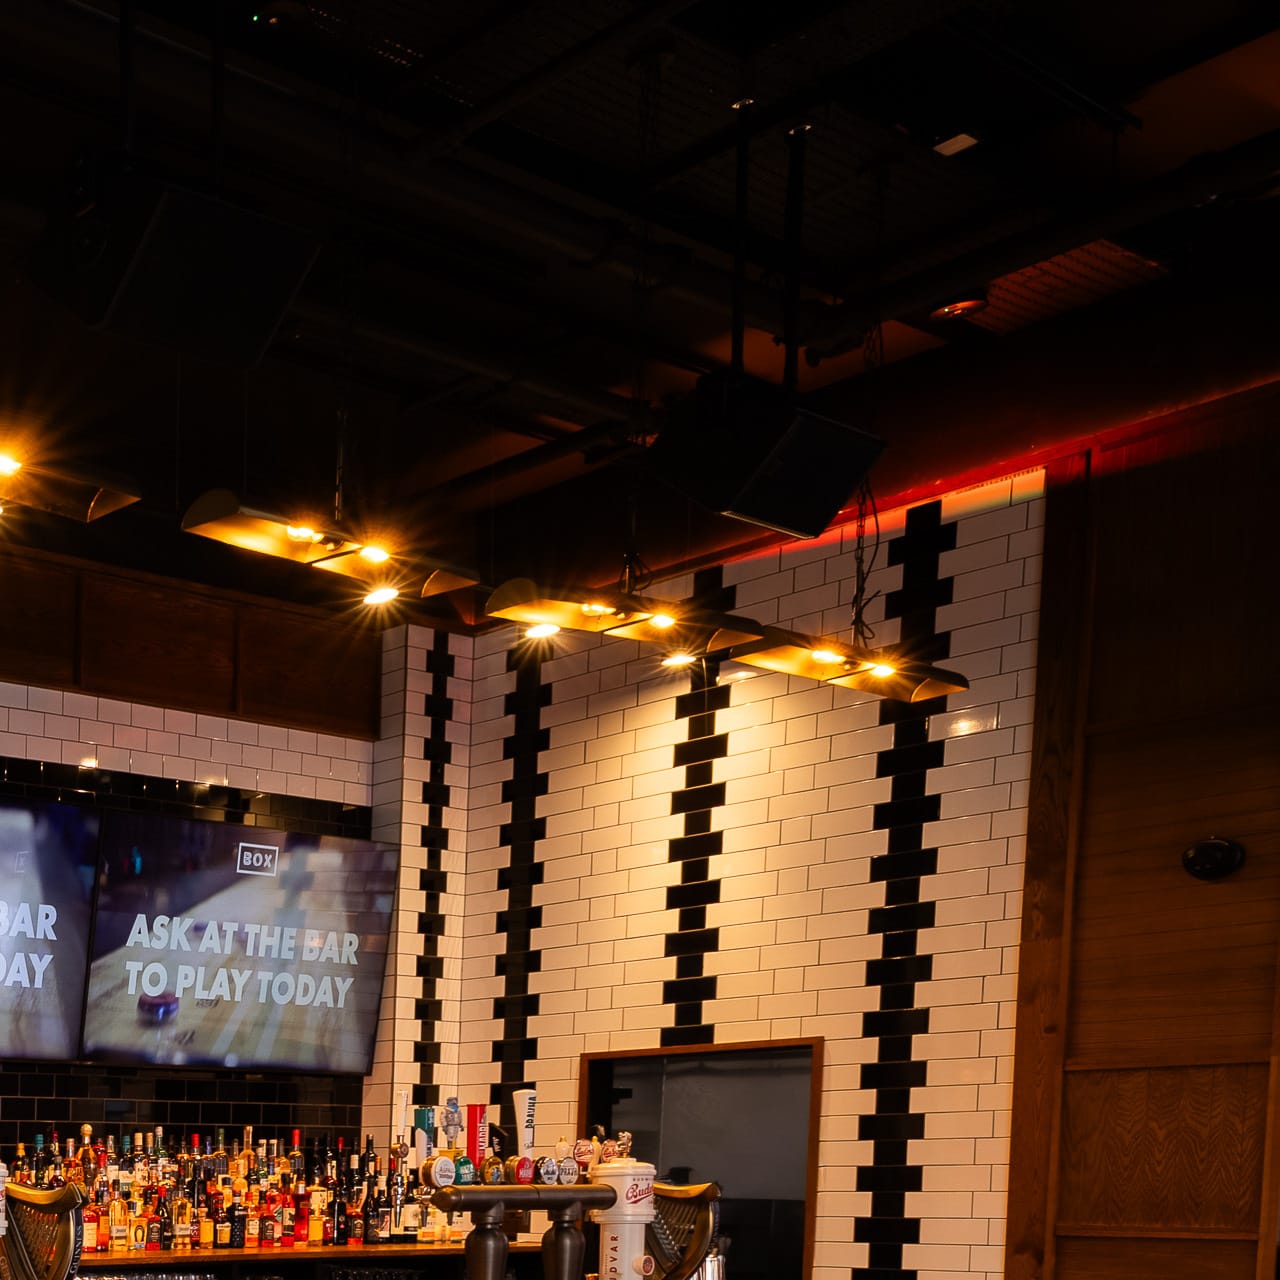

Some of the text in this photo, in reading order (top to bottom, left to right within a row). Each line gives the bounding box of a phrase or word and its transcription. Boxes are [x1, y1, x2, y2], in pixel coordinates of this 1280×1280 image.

[243, 851, 272, 869] BOX
[126, 913, 360, 965] ASK AT THE BAR
[125, 961, 354, 1009] TO PLAY TODAY
[525, 1095, 537, 1129] PRAVHA
[70, 1225, 83, 1274] GUINNESS
